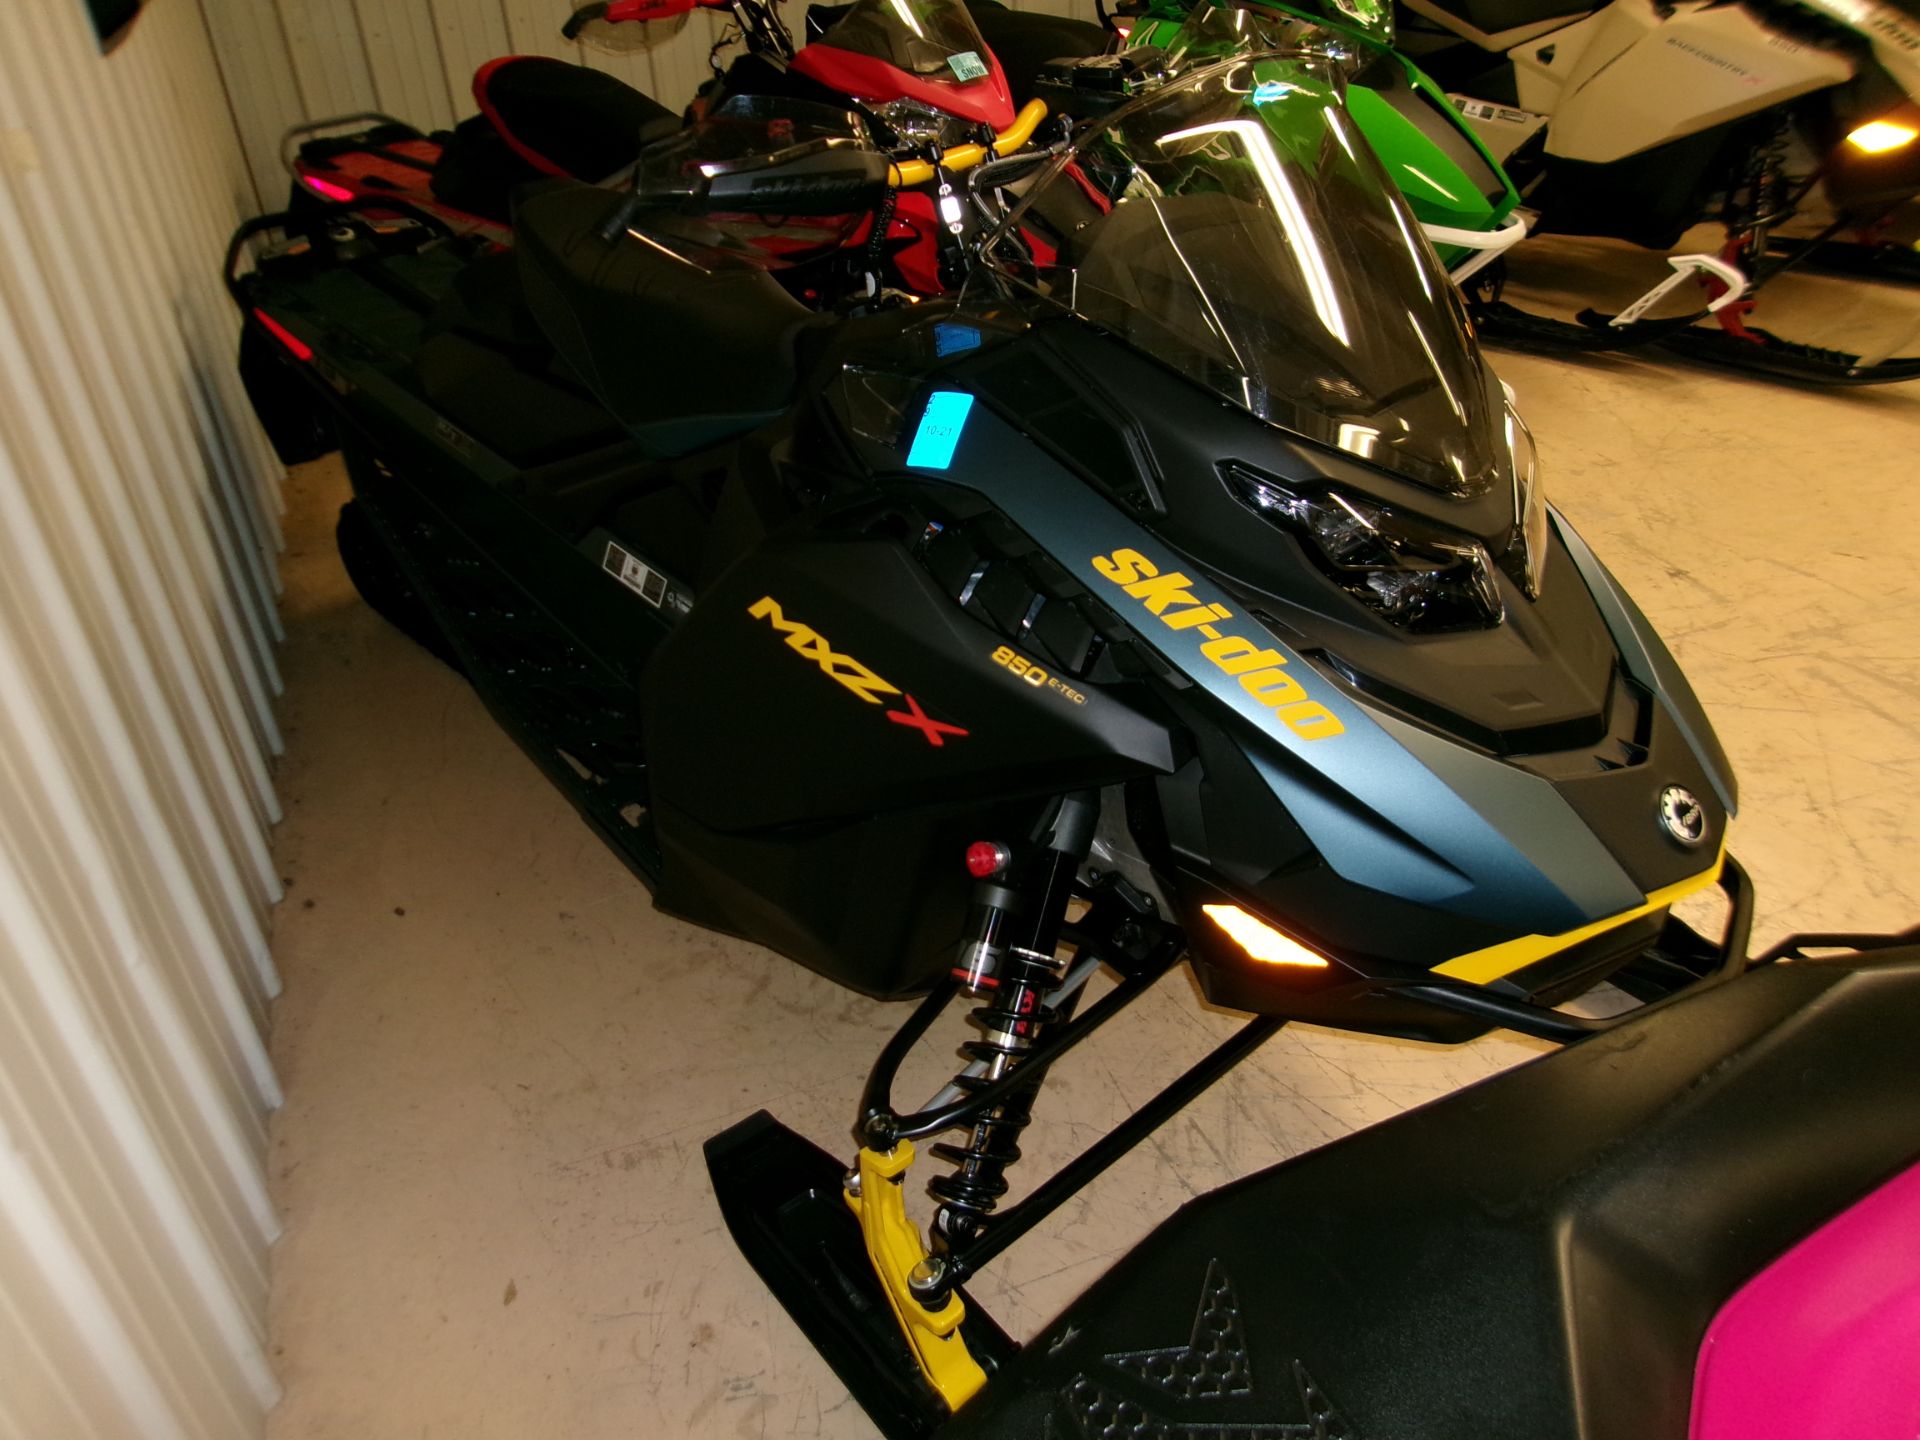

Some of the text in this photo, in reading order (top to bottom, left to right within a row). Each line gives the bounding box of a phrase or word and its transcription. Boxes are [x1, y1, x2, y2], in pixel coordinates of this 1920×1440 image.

[961, 65, 985, 78] SNOW
[926, 425, 952, 437] 10-21
[1091, 547, 1346, 742] ski-doo
[991, 645, 1086, 704] 850 E-TEC
